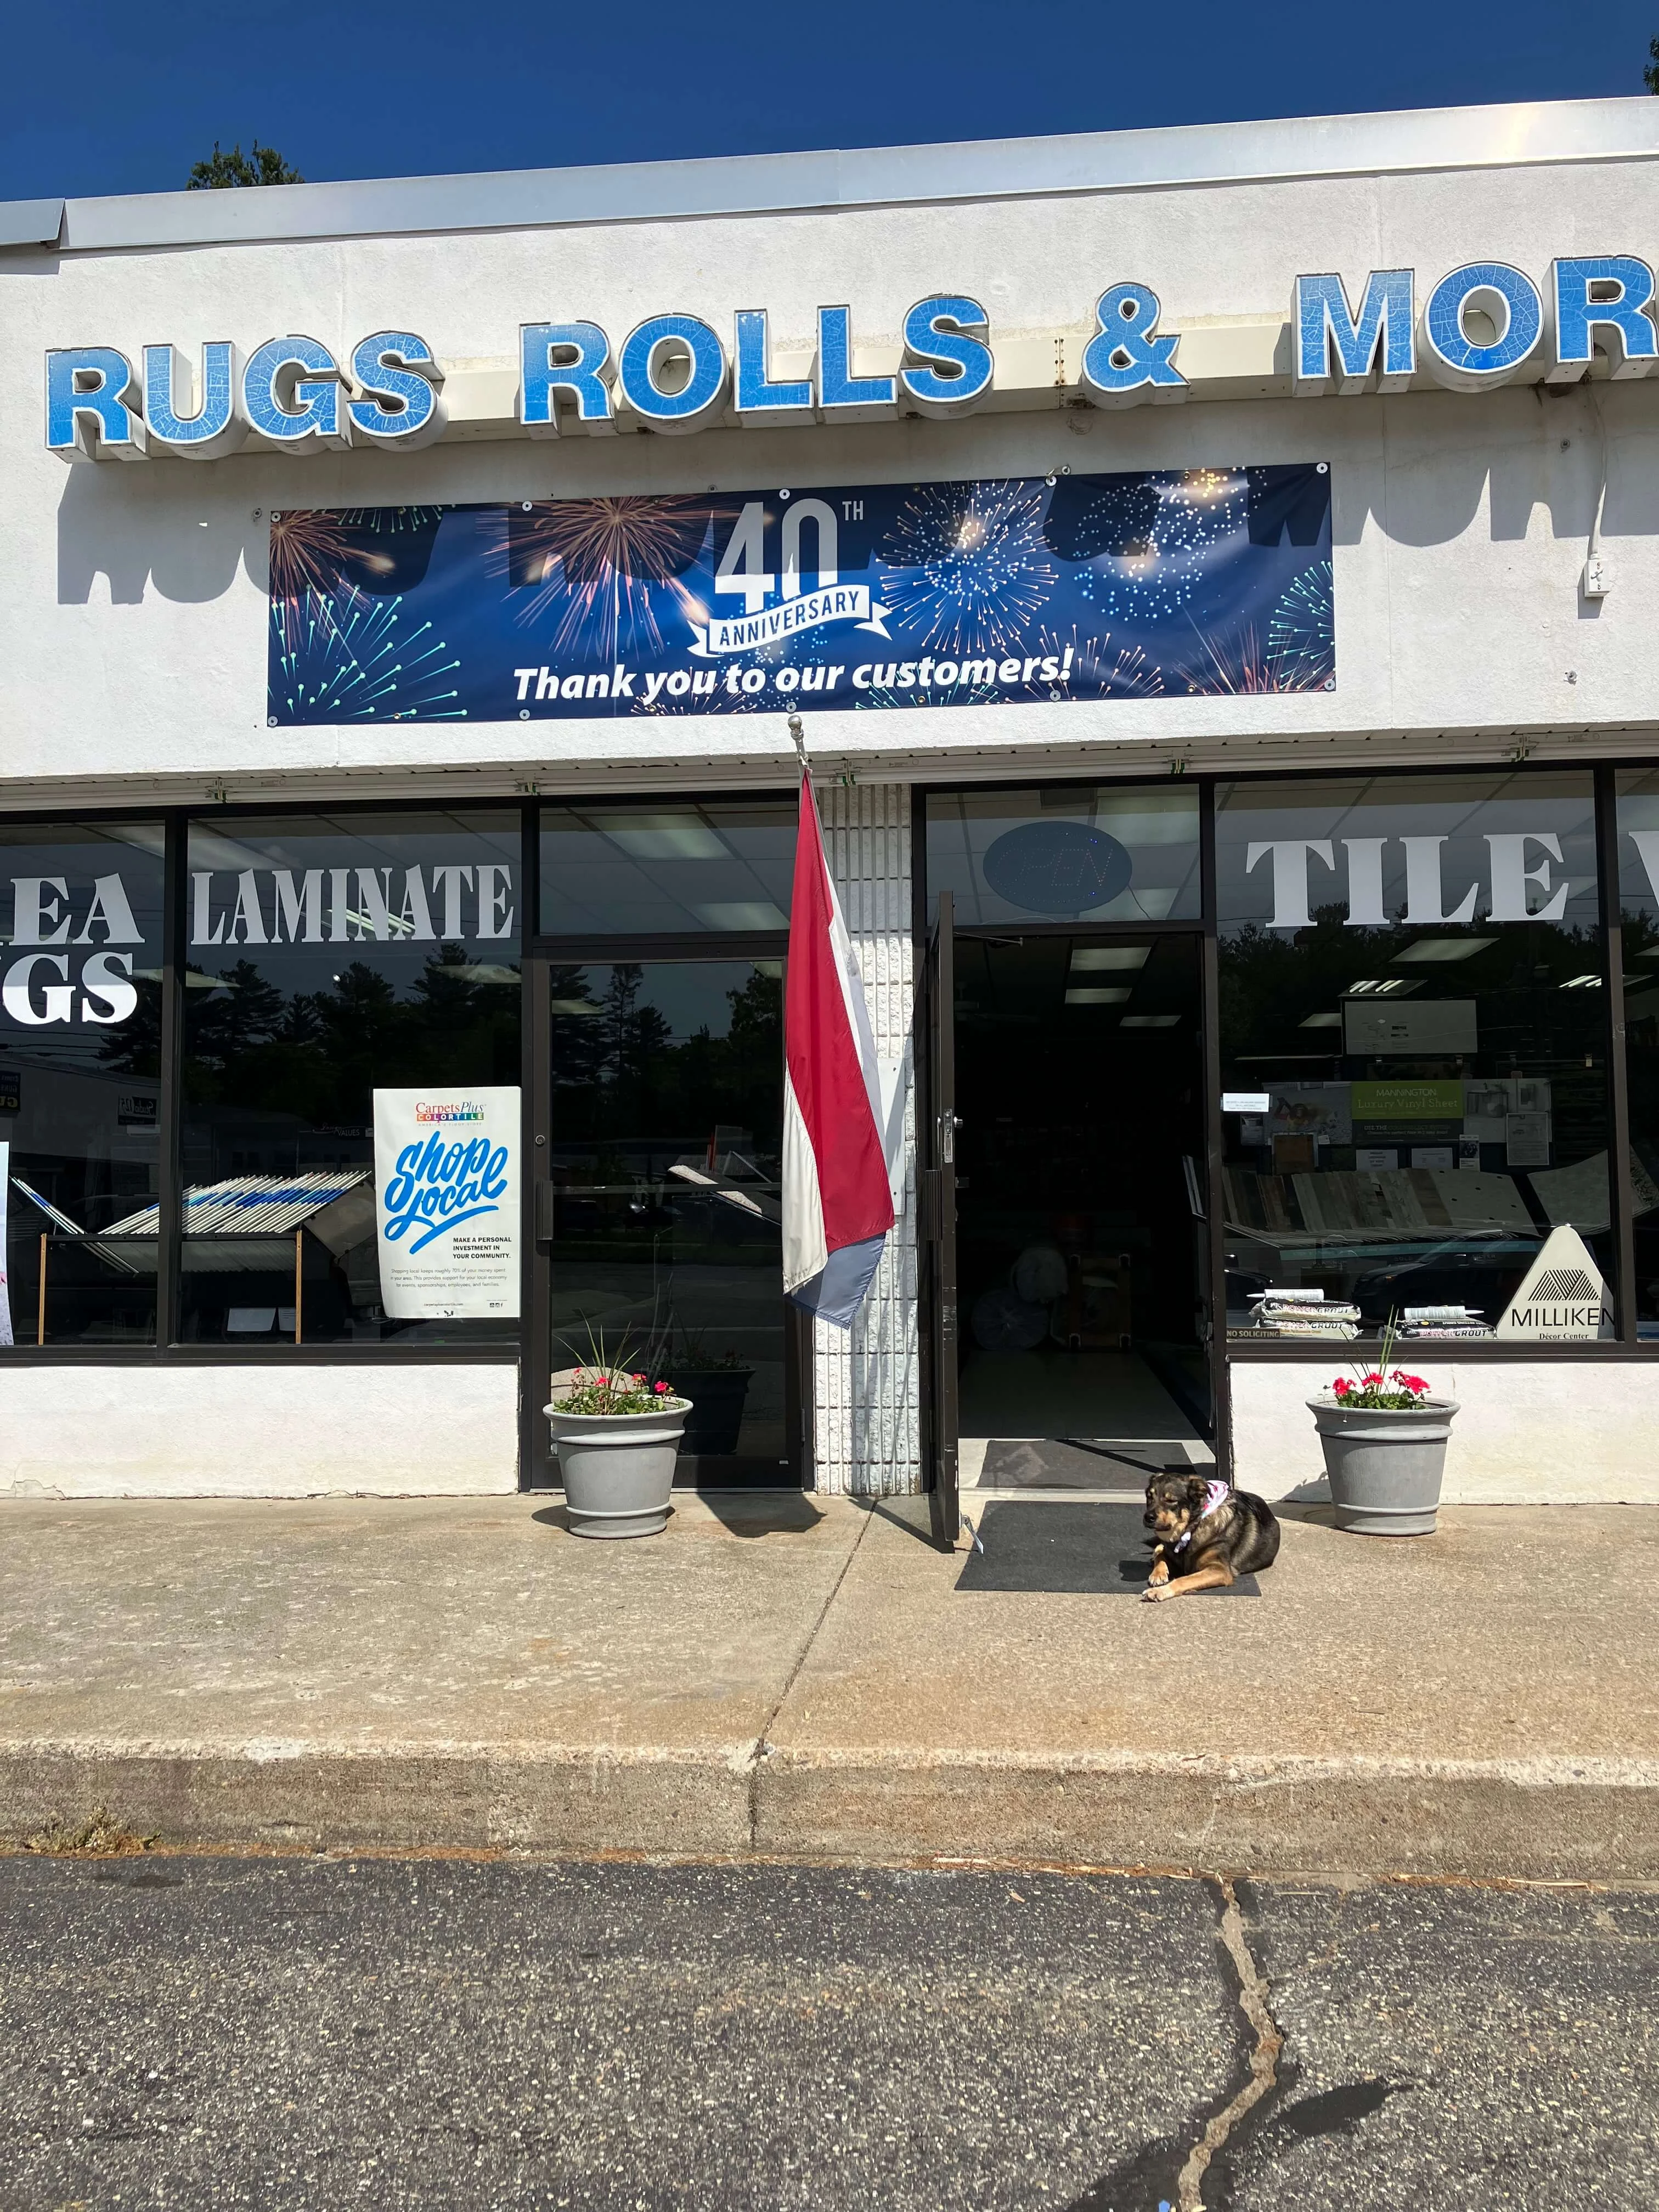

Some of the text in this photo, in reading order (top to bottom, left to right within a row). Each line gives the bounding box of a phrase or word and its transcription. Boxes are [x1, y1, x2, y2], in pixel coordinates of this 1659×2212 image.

[45, 254, 1659, 449] RUGS ROLLS & MOR
[719, 590, 860, 646] ANNIVERSARY
[514, 647, 1075, 707] Thank you to our customers!
[190, 864, 514, 945] LAMINATE
[1245, 832, 1570, 928] TILE
[0, 873, 146, 946] EA
[0, 952, 138, 1025] GS
[1358, 1097, 1458, 1110] Luxury Vinyl Sheet
[1376, 1088, 1437, 1097] MANNINGTON
[1238, 1330, 1280, 1339] SOLICITING
[1284, 1304, 1317, 1313] POWER
[1511, 1307, 1615, 1327] MILLIKEN
